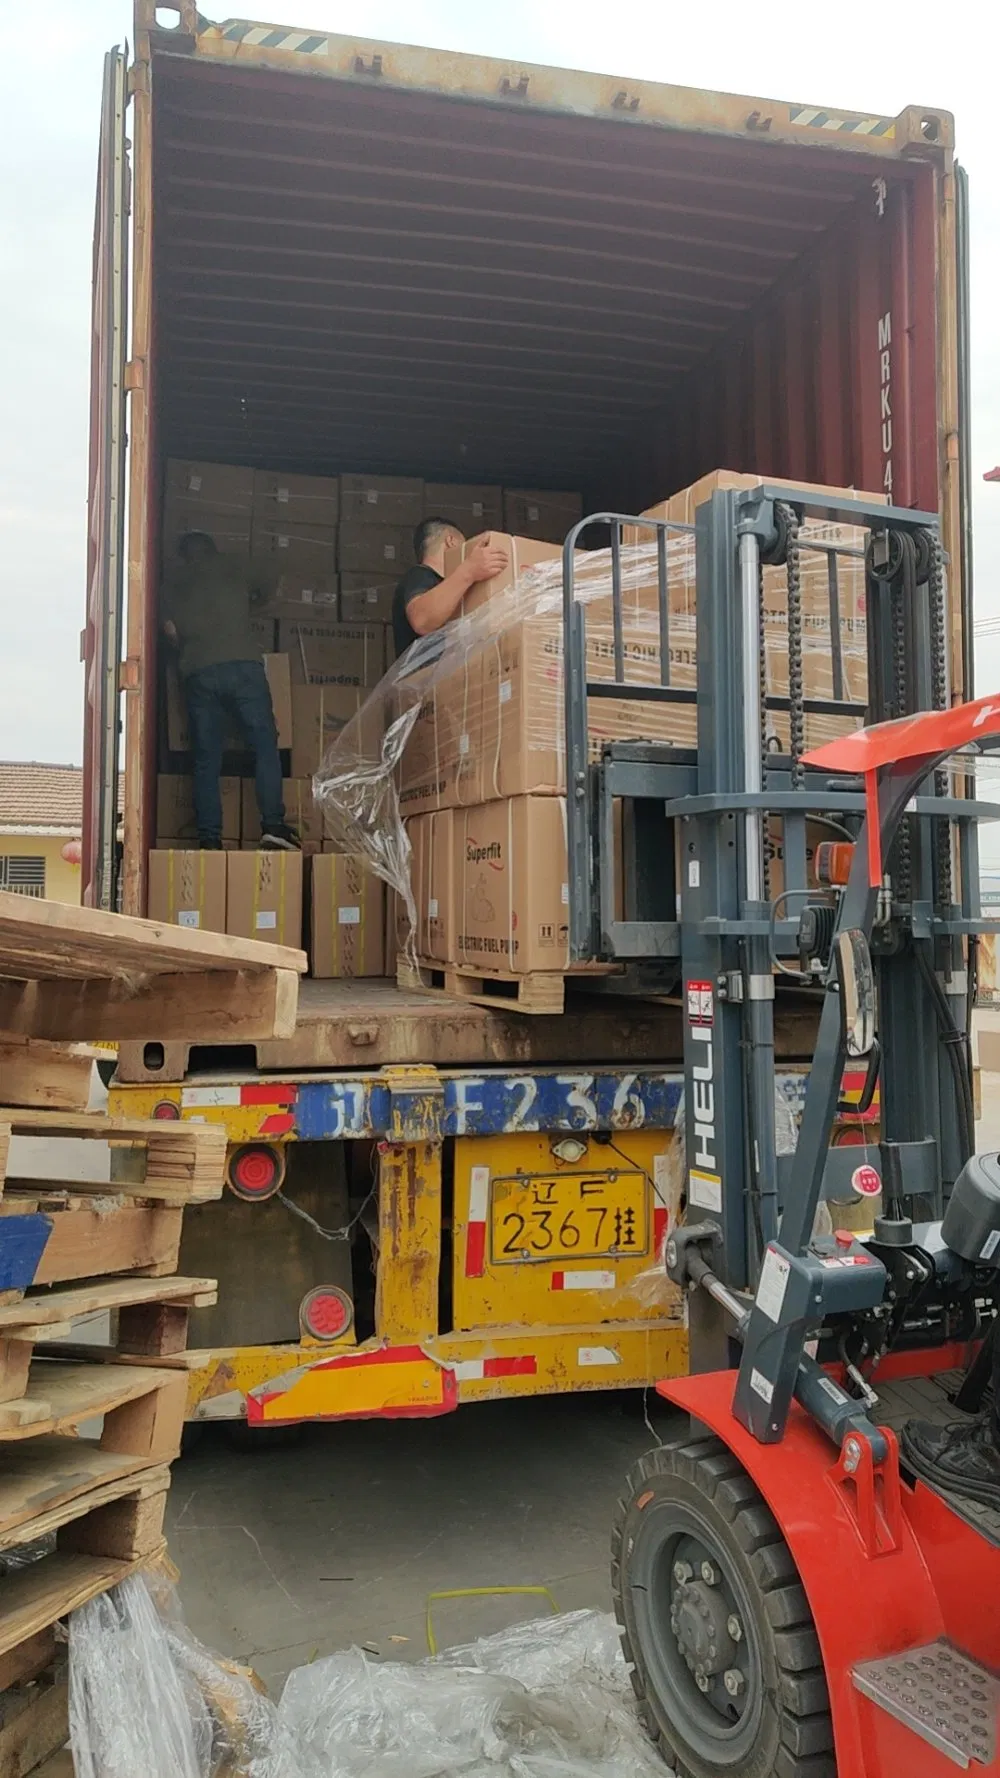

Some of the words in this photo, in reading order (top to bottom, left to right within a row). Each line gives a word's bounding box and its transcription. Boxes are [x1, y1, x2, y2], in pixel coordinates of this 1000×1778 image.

[633, 645, 697, 665] ELECRIC
[466, 841, 502, 865] Superfit
[484, 938, 499, 953] FUEL
[691, 1025, 717, 1170] HELI
